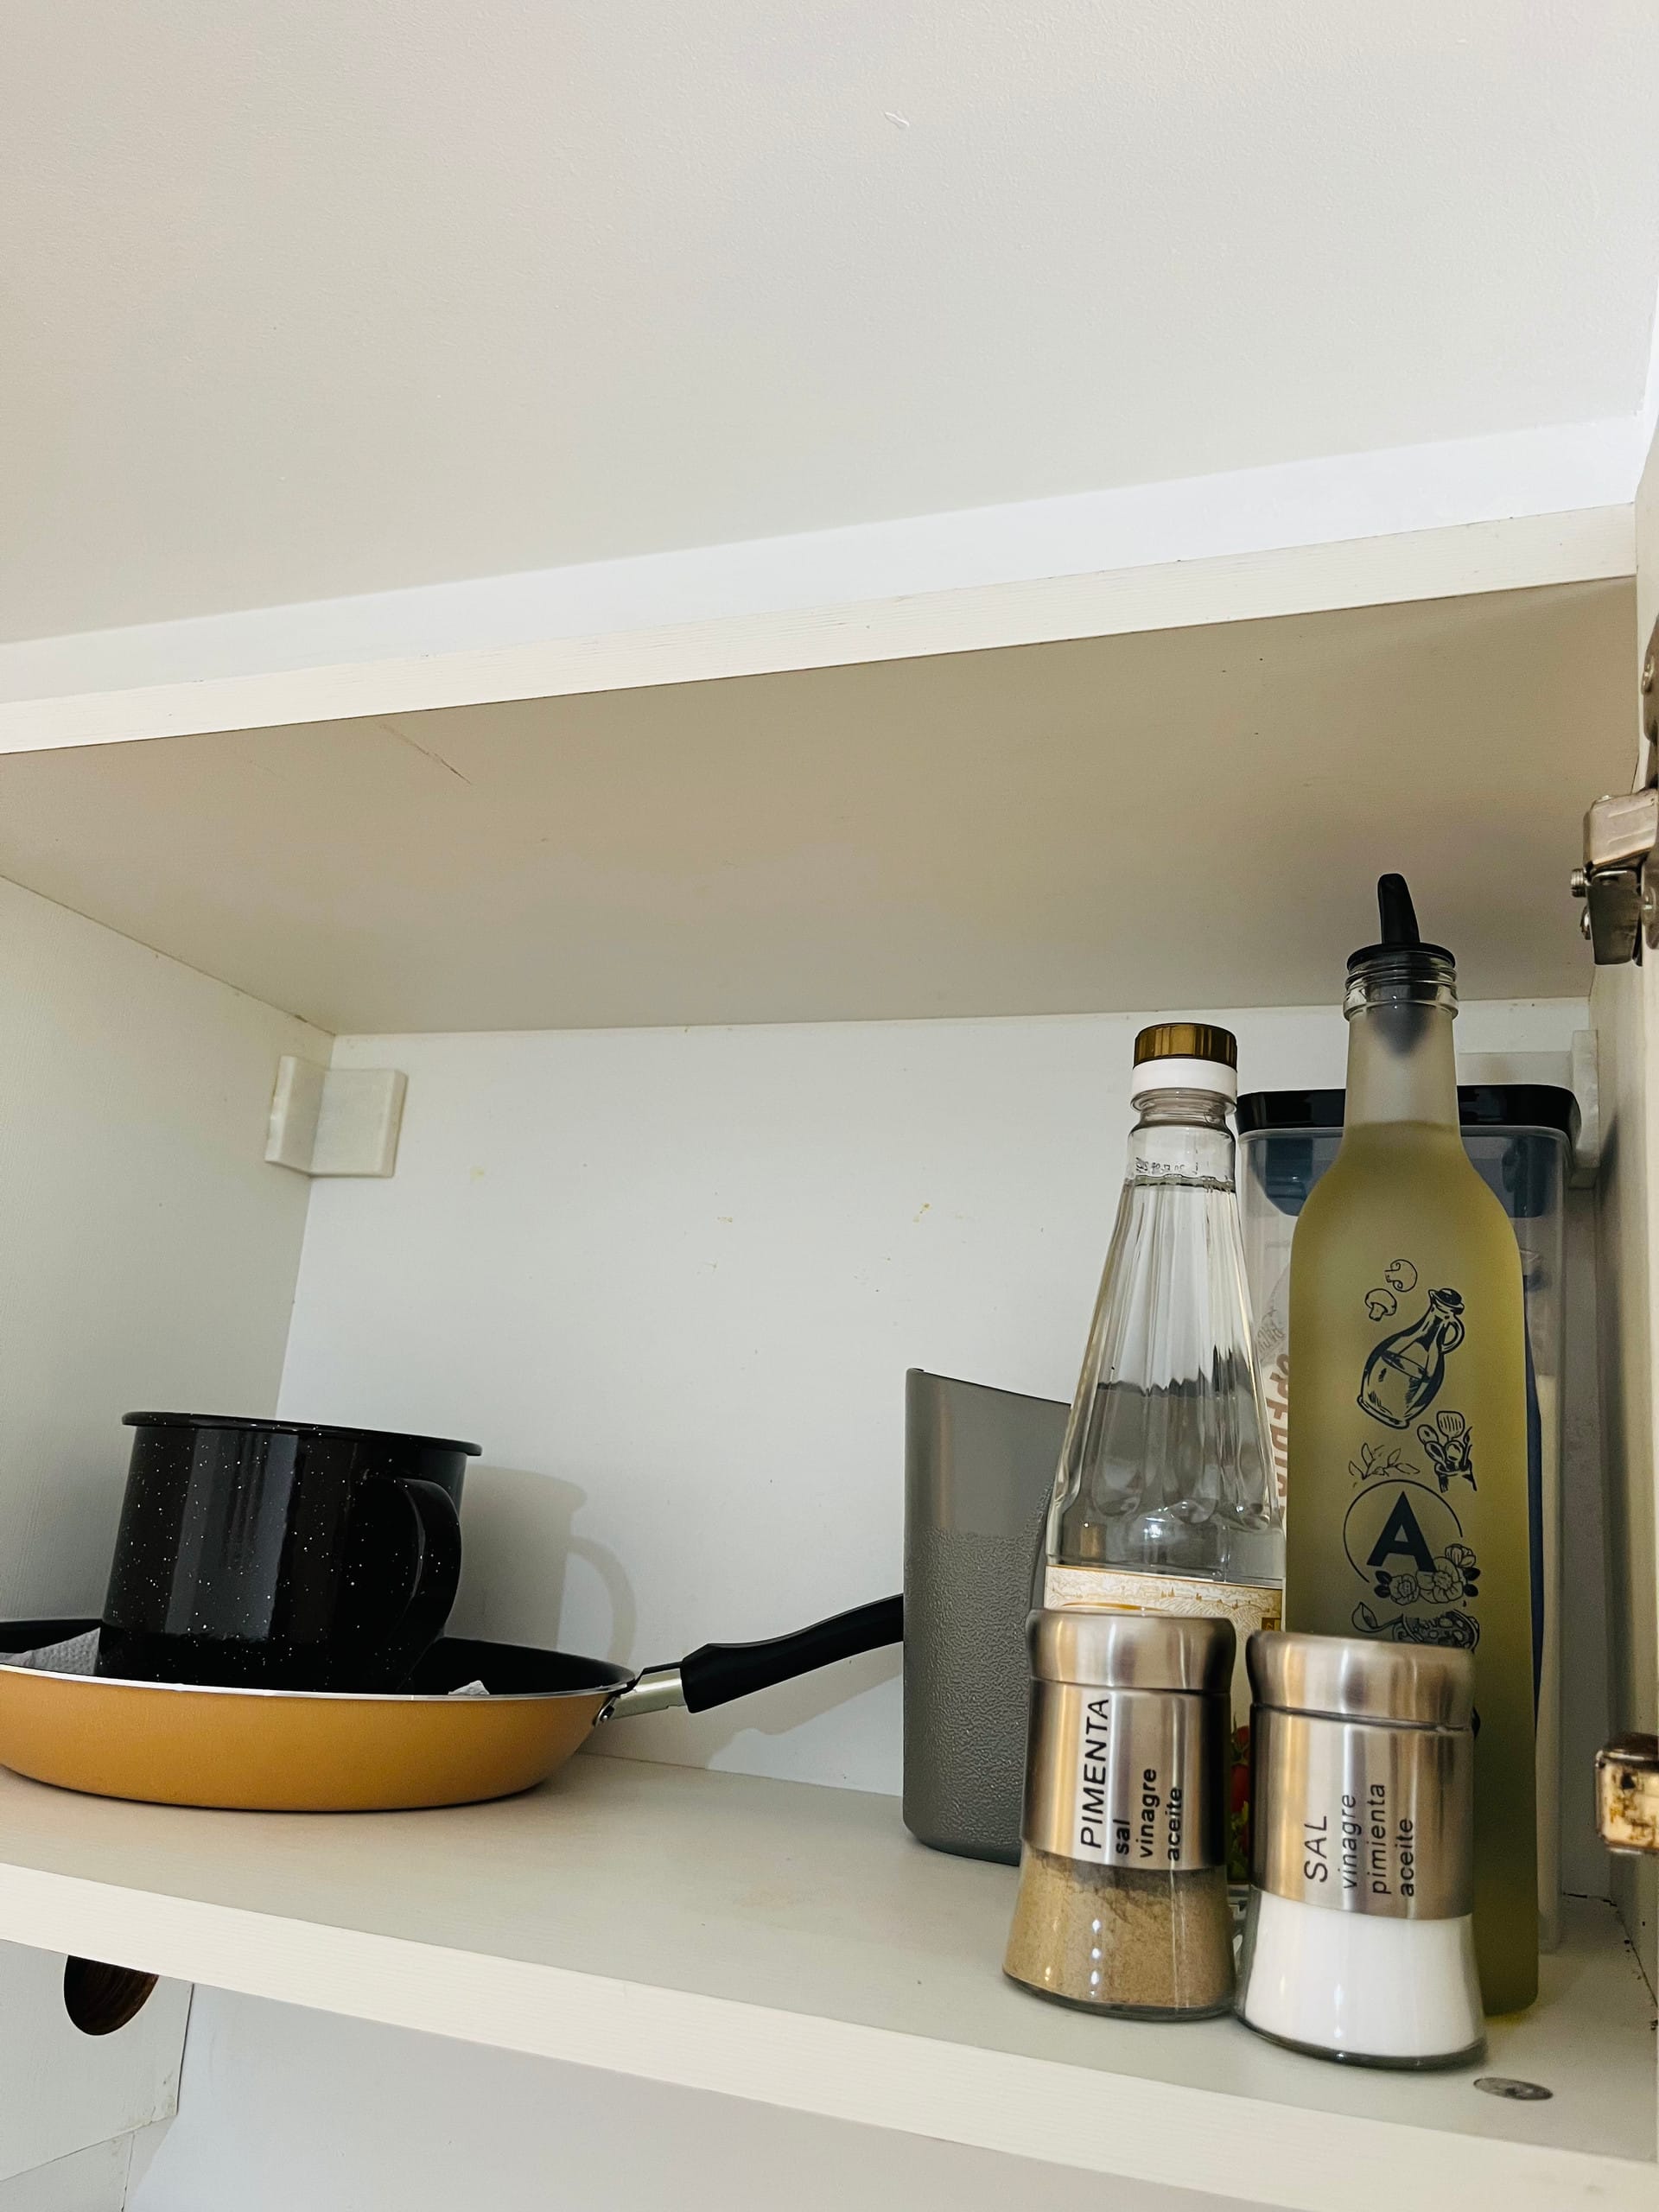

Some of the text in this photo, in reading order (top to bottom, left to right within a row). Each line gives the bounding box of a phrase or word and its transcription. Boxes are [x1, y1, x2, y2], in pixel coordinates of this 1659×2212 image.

[1366, 1491, 1437, 1573] A
[1081, 1699, 1109, 1848] PIMENTA
[1135, 1768, 1160, 1858] vinagre
[1113, 1818, 1131, 1856] sal
[1165, 1787, 1182, 1861] aceite
[1304, 1815, 1328, 1884] SAL
[1338, 1794, 1362, 1889] vinagre
[1366, 1783, 1392, 1895] pimienta
[1395, 1818, 1415, 1897] aceite
